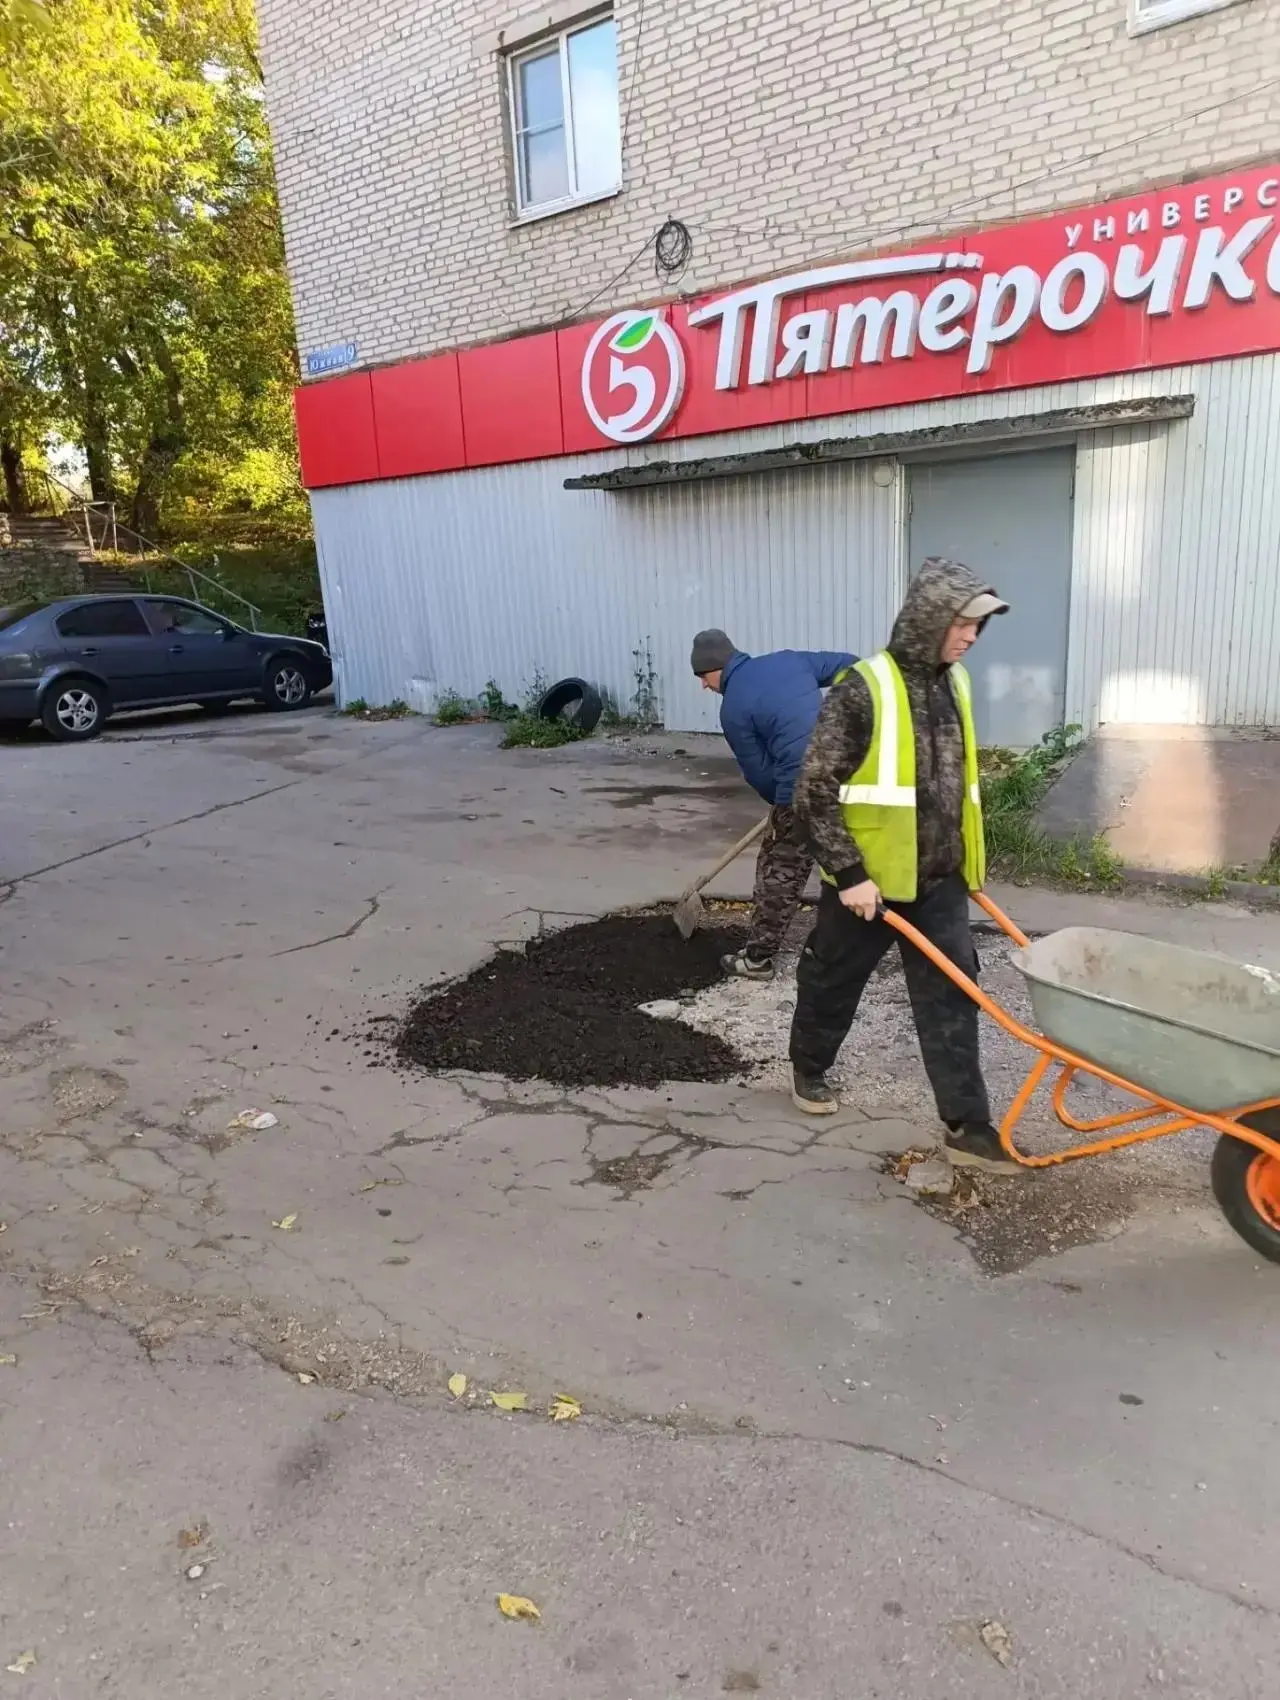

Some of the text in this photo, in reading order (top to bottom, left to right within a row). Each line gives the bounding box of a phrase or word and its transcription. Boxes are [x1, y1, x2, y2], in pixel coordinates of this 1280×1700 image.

[1065, 179, 1280, 248] УНИВЕРС
[688, 215, 1280, 390] Пятёрочк
[347, 344, 355, 362] 9
[607, 355, 656, 436] 5
